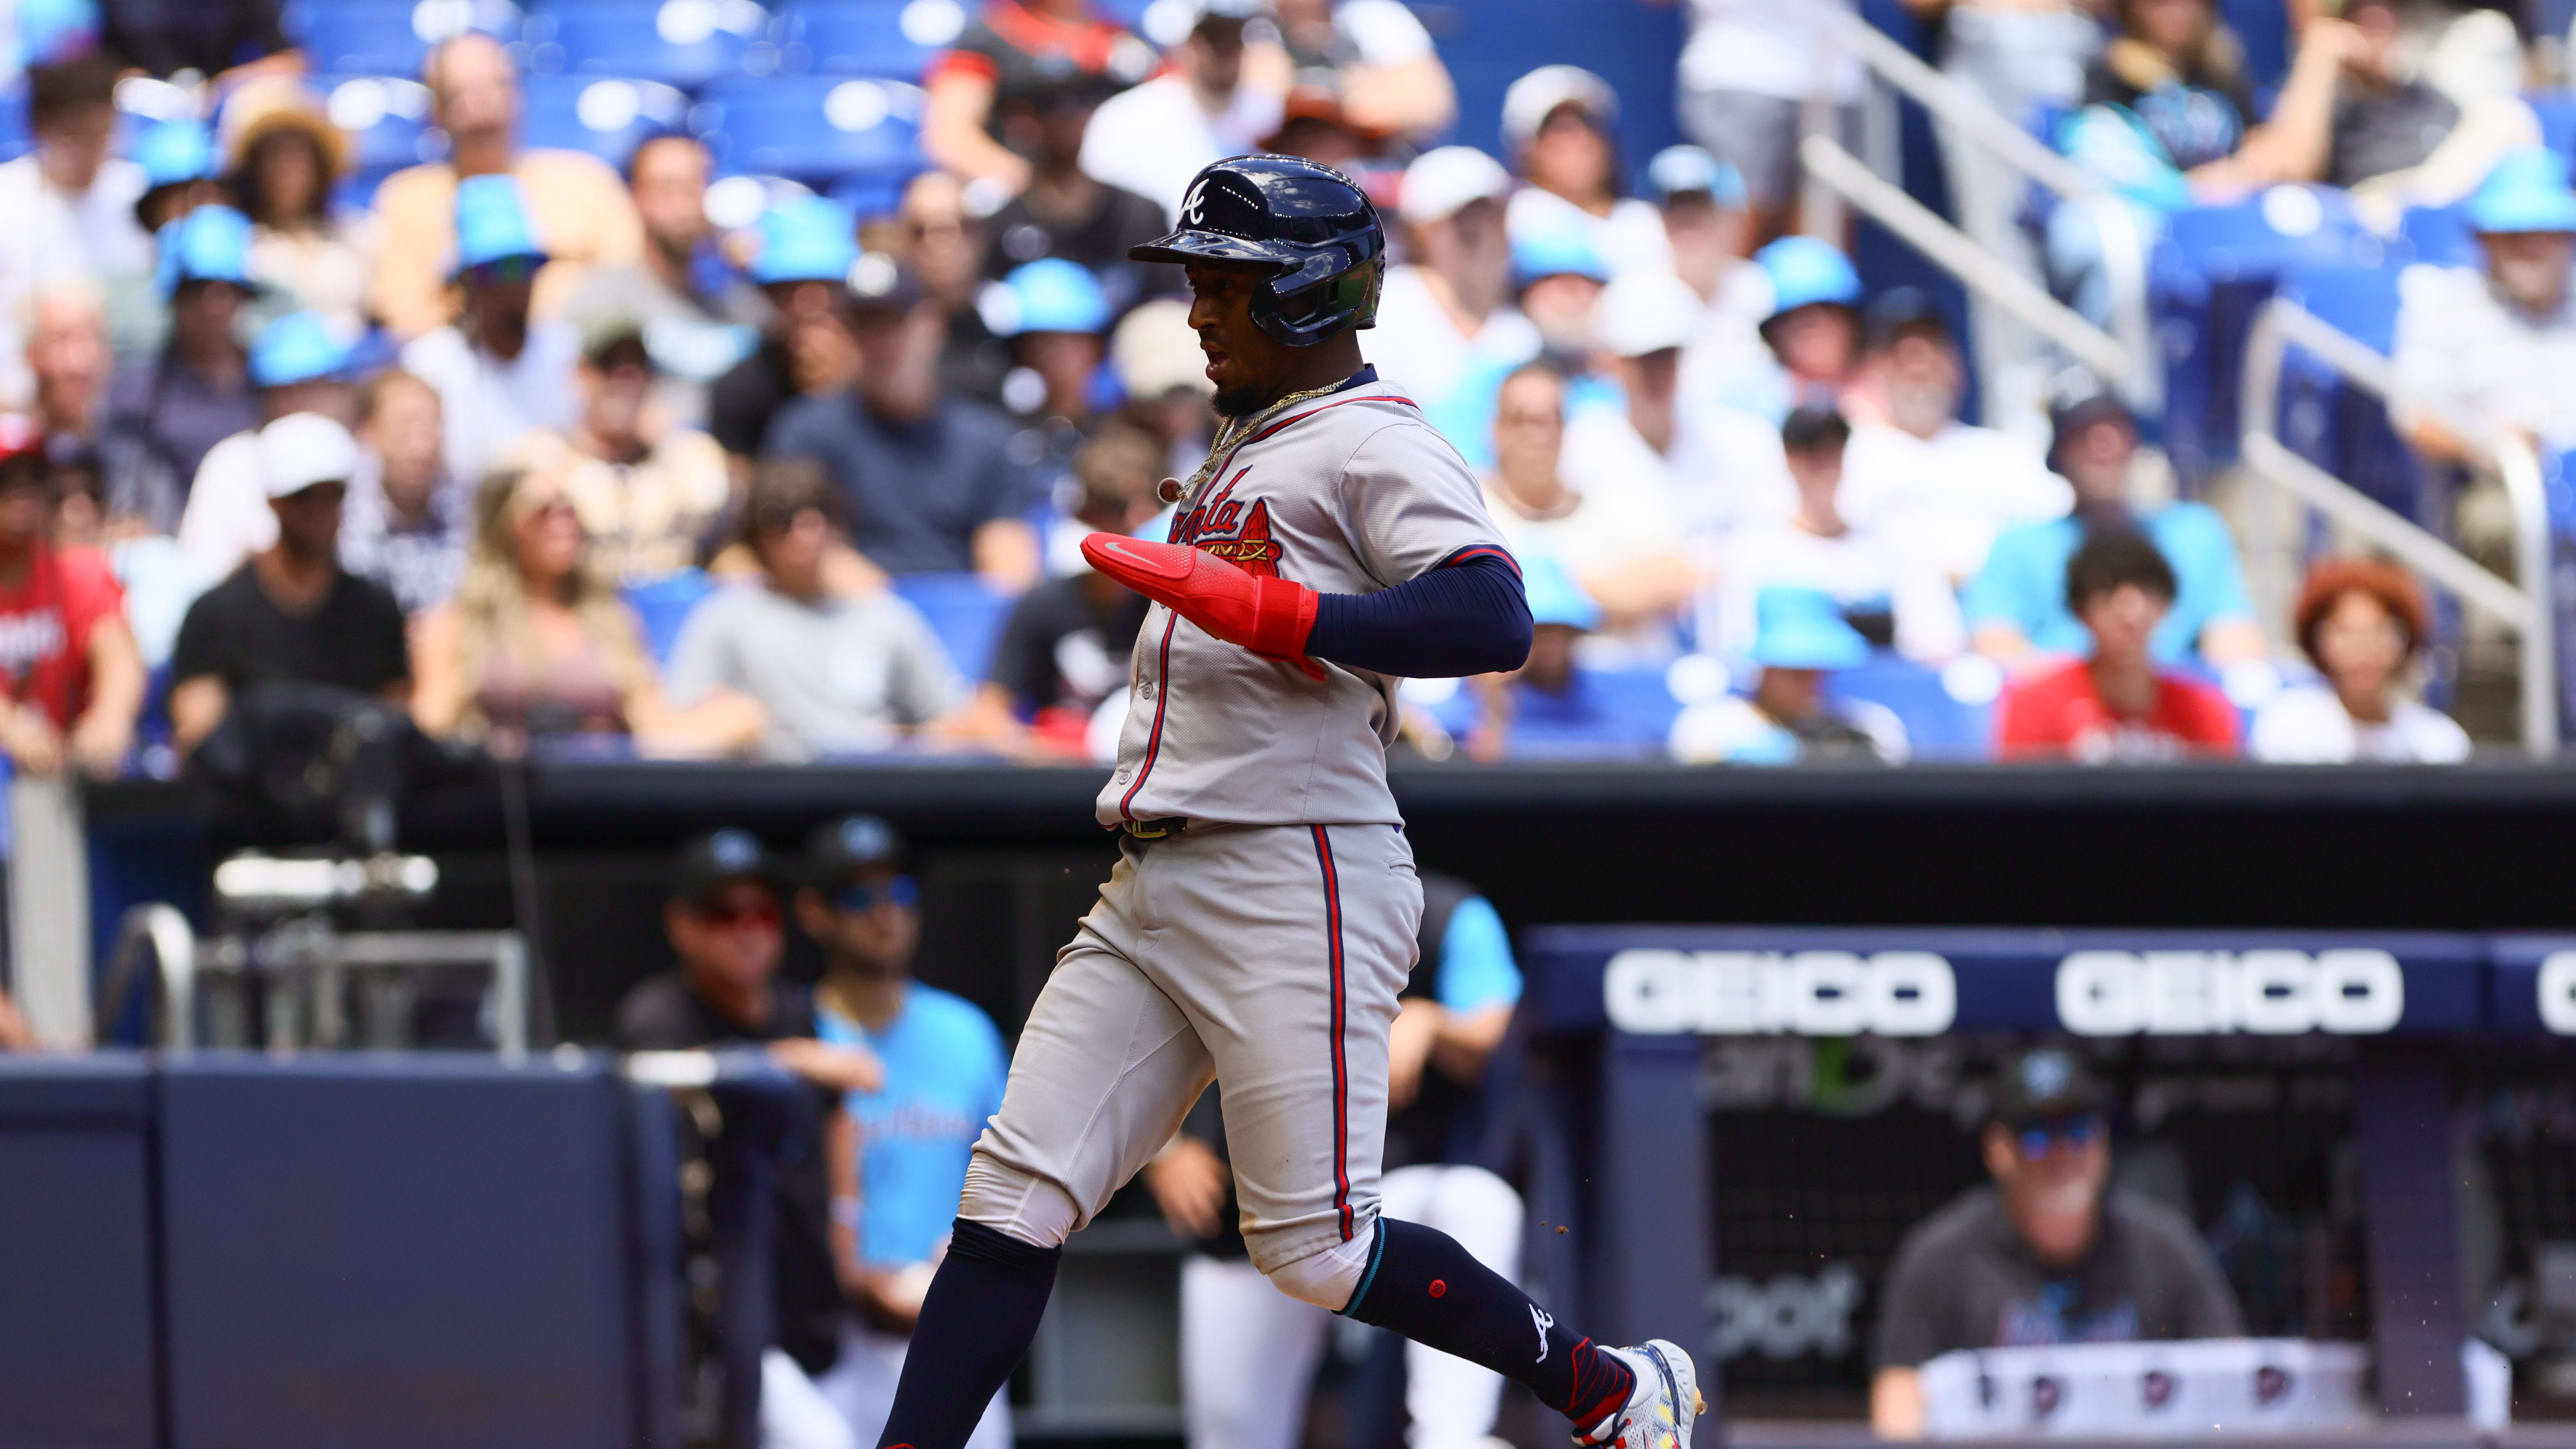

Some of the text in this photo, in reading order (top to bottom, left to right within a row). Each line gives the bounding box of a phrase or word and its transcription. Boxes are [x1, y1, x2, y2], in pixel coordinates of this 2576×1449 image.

[1176, 178, 1209, 225] A
[1603, 949, 1957, 1035] GEICO
[2056, 949, 2404, 1034] GEICO
